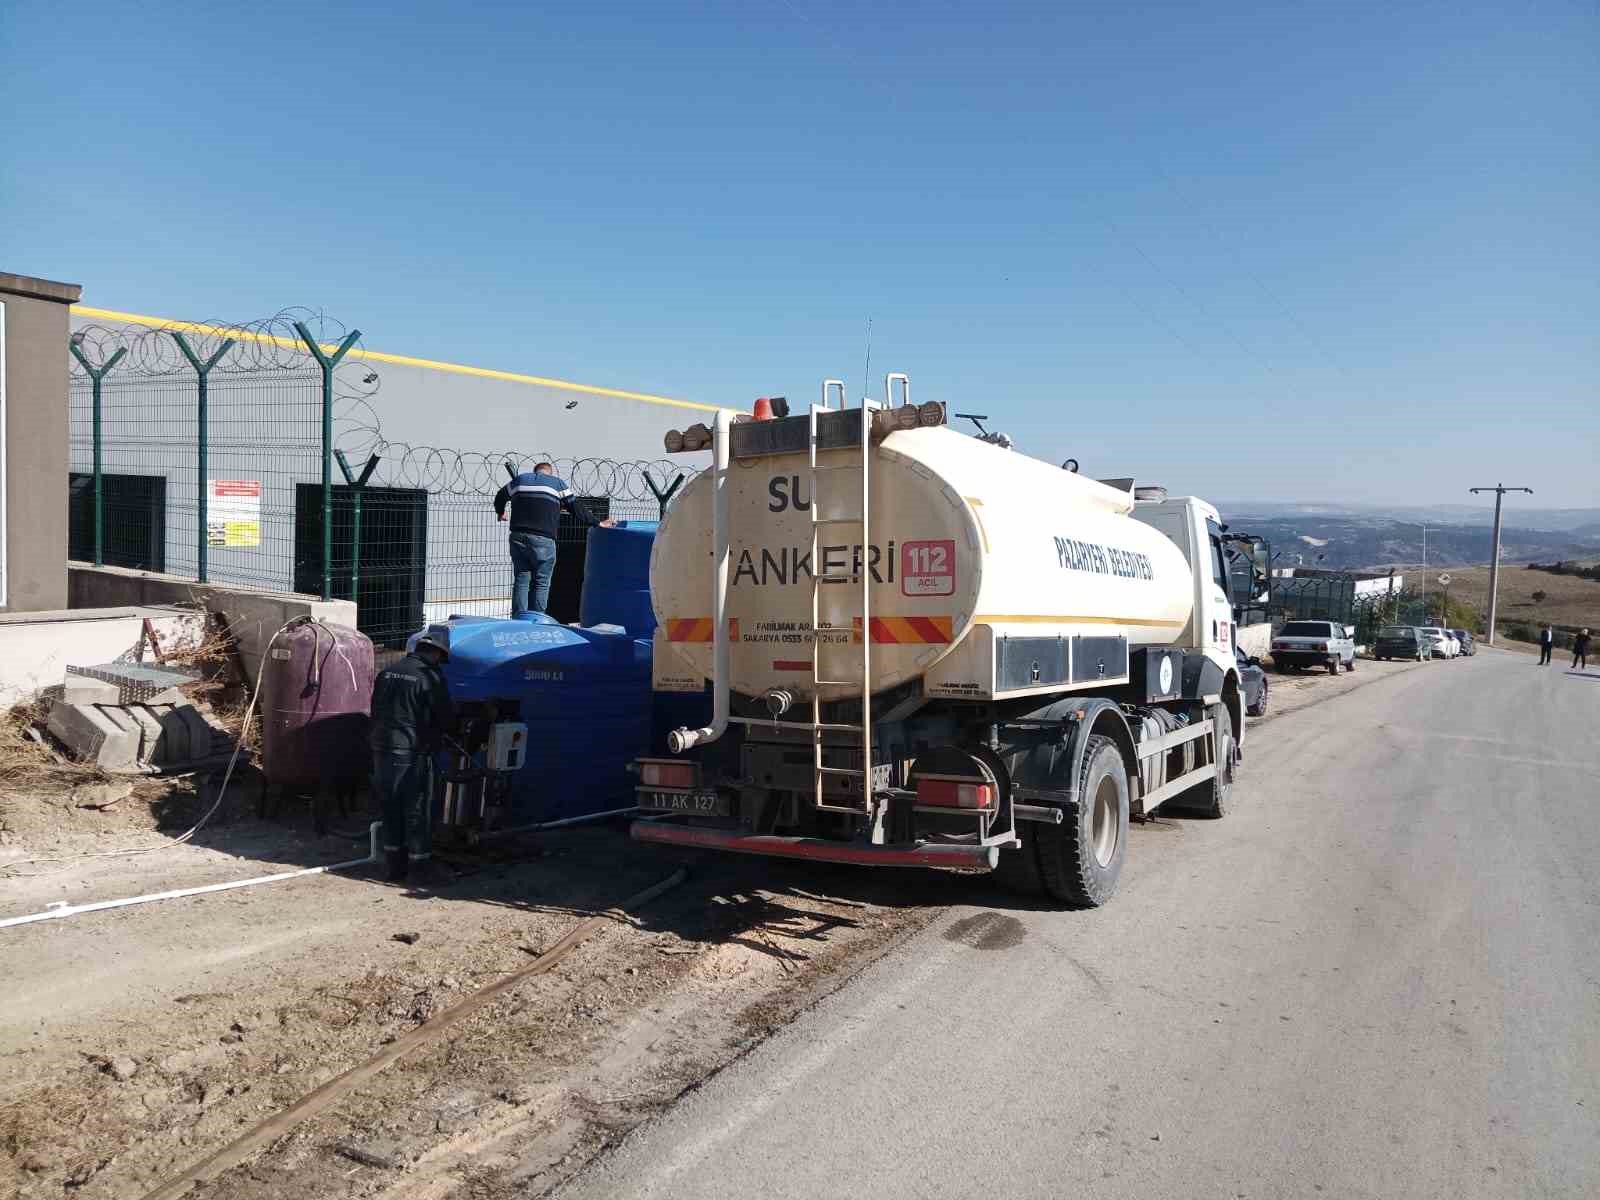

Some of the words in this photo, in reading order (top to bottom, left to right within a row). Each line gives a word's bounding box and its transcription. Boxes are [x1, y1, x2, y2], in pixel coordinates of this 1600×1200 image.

[768, 475, 812, 513] SU
[710, 540, 895, 586] ANKERİ
[909, 546, 947, 573] 112
[654, 793, 666, 808] 11
[671, 794, 688, 809] AK
[694, 795, 714, 810] 127
